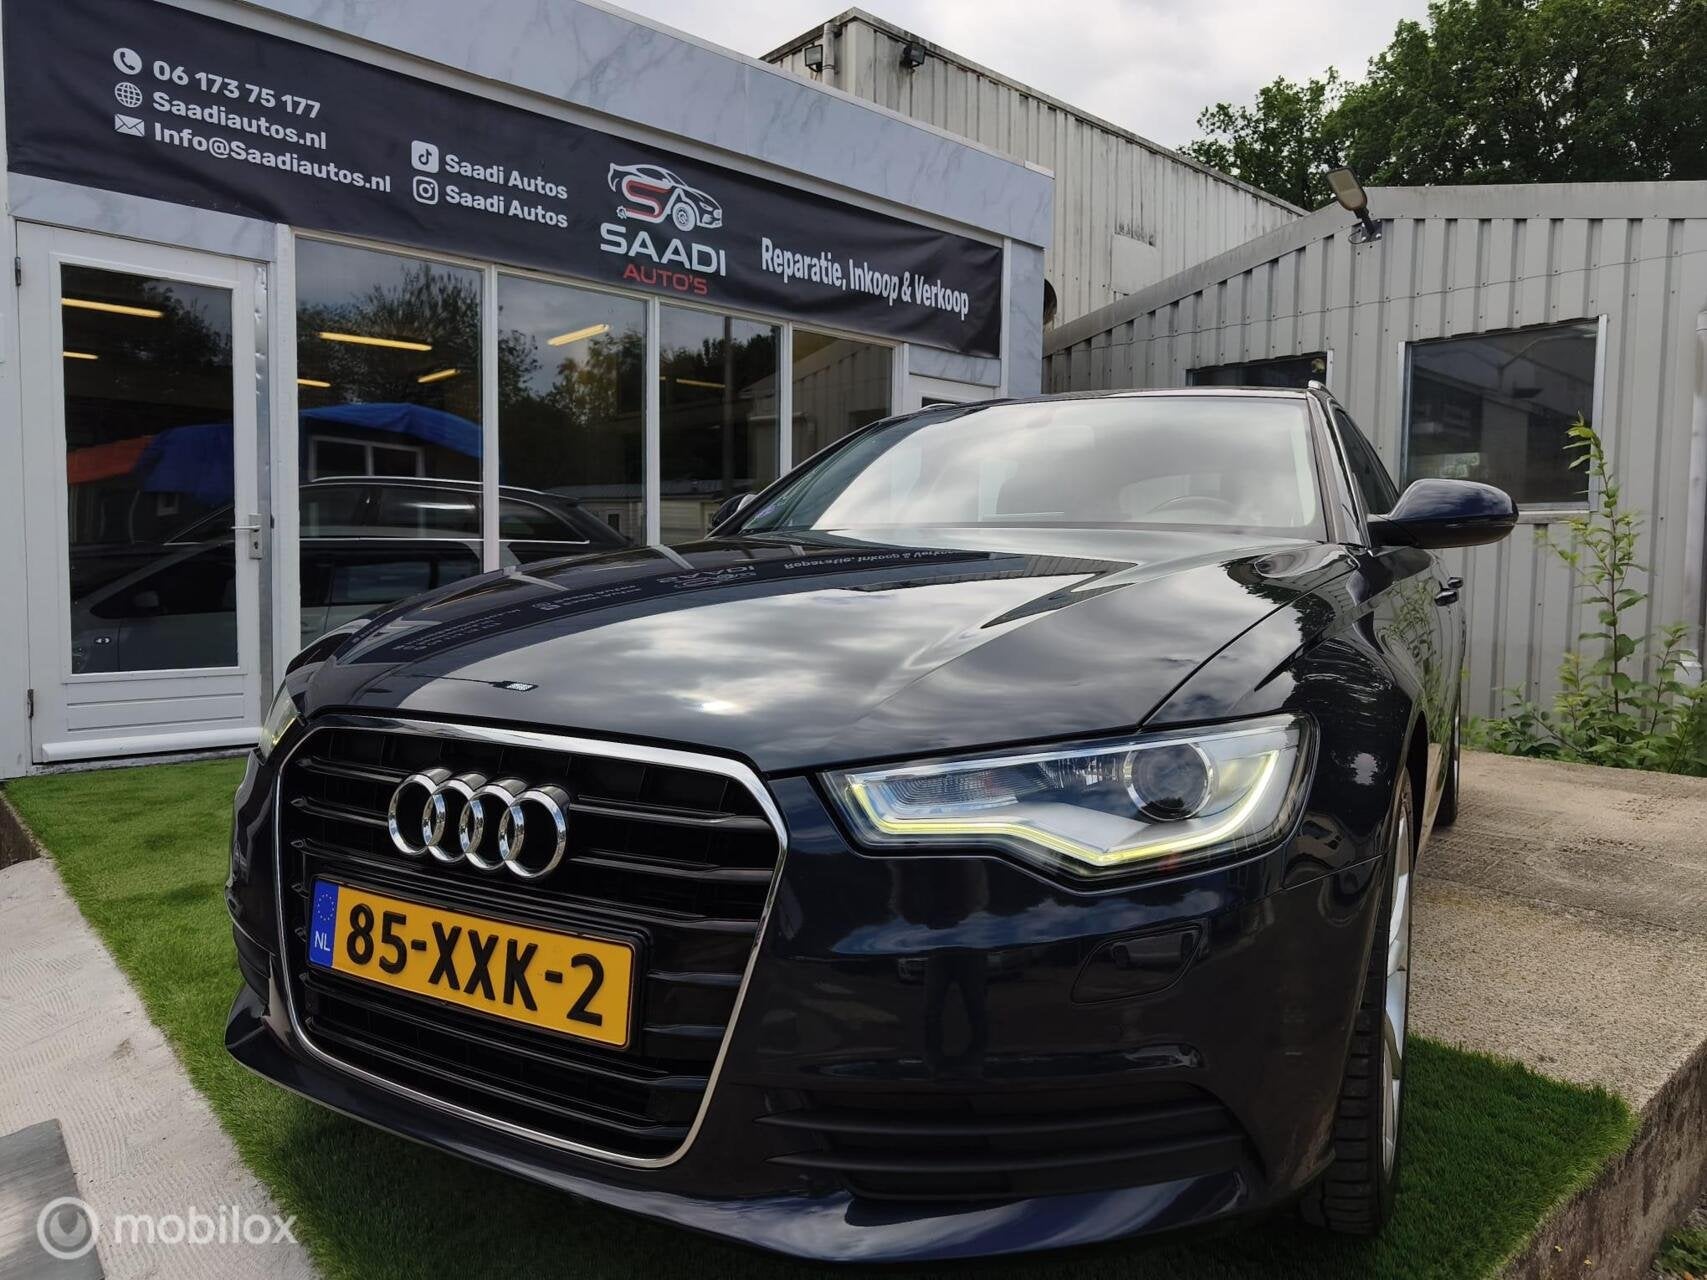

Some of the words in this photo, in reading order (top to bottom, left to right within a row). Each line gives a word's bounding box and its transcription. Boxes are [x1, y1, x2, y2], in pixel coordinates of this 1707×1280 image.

[153, 60, 189, 86] 06
[194, 72, 240, 99] 173
[245, 84, 276, 108] 75
[281, 94, 321, 119] 177
[152, 91, 327, 150] Saadiautos.nl
[154, 122, 391, 193] Info@Saadiautos.nl
[445, 154, 504, 185] Saadi
[508, 170, 568, 200] Autos
[445, 185, 504, 215] Saadi
[508, 200, 569, 228] Autos
[600, 222, 726, 277] SAADI
[623, 263, 708, 296] AUTO'S
[761, 237, 847, 291] Reparatie,
[849, 259, 899, 306] Inkoop
[901, 271, 912, 303] &
[914, 274, 969, 321] Verkoop
[313, 930, 331, 952] NL
[346, 903, 604, 1027] 85-XXK-2
